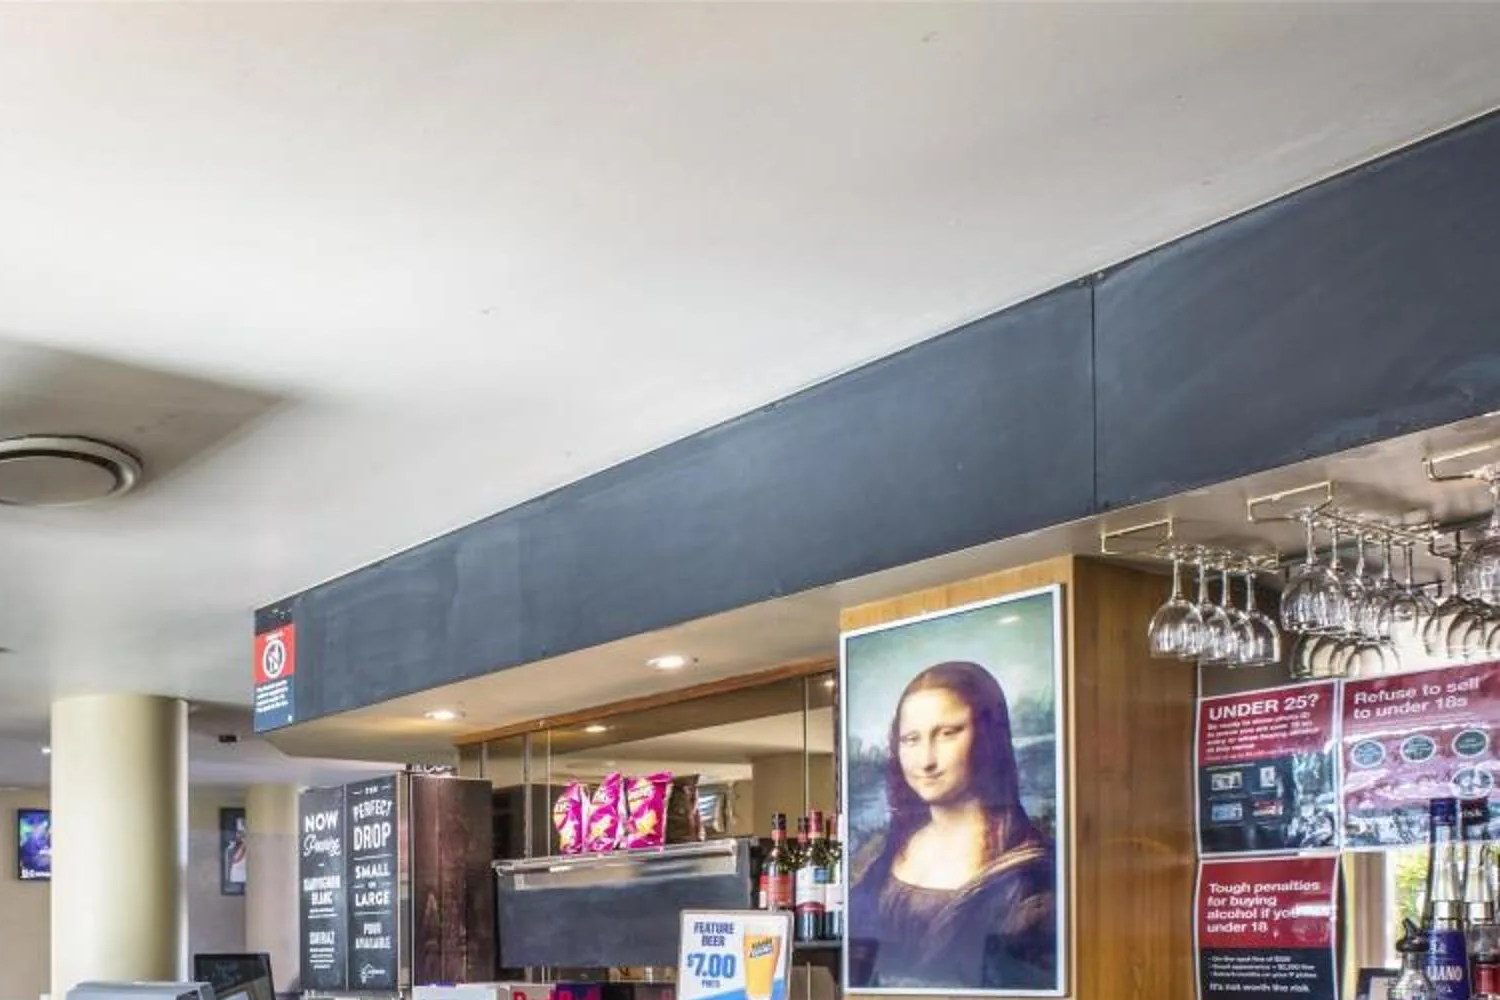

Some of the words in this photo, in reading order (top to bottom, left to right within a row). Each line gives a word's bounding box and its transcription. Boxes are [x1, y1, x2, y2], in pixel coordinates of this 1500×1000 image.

[1354, 687, 1417, 705] Refuse
[1422, 684, 1441, 696] to
[1447, 678, 1480, 692] sell
[1209, 699, 1279, 720] UNDER
[1284, 693, 1319, 711] 25?
[1353, 708, 1371, 719] to
[1376, 700, 1430, 717] under
[353, 799, 393, 822] PERFECT
[305, 810, 339, 833] NOW
[353, 821, 392, 851] DROP
[355, 863, 392, 880] SMALL
[1208, 882, 1251, 895] Tough
[1253, 879, 1321, 894] penalties
[355, 890, 391, 908] LARGE
[1207, 896, 1228, 907] for
[1229, 896, 1277, 908] buying
[1207, 908, 1258, 920] alcohol
[1261, 907, 1271, 919] if
[693, 921, 736, 935] FEATURE
[1207, 923, 1248, 933] under
[701, 935, 726, 947] BEER
[687, 952, 737, 979] $7.00
